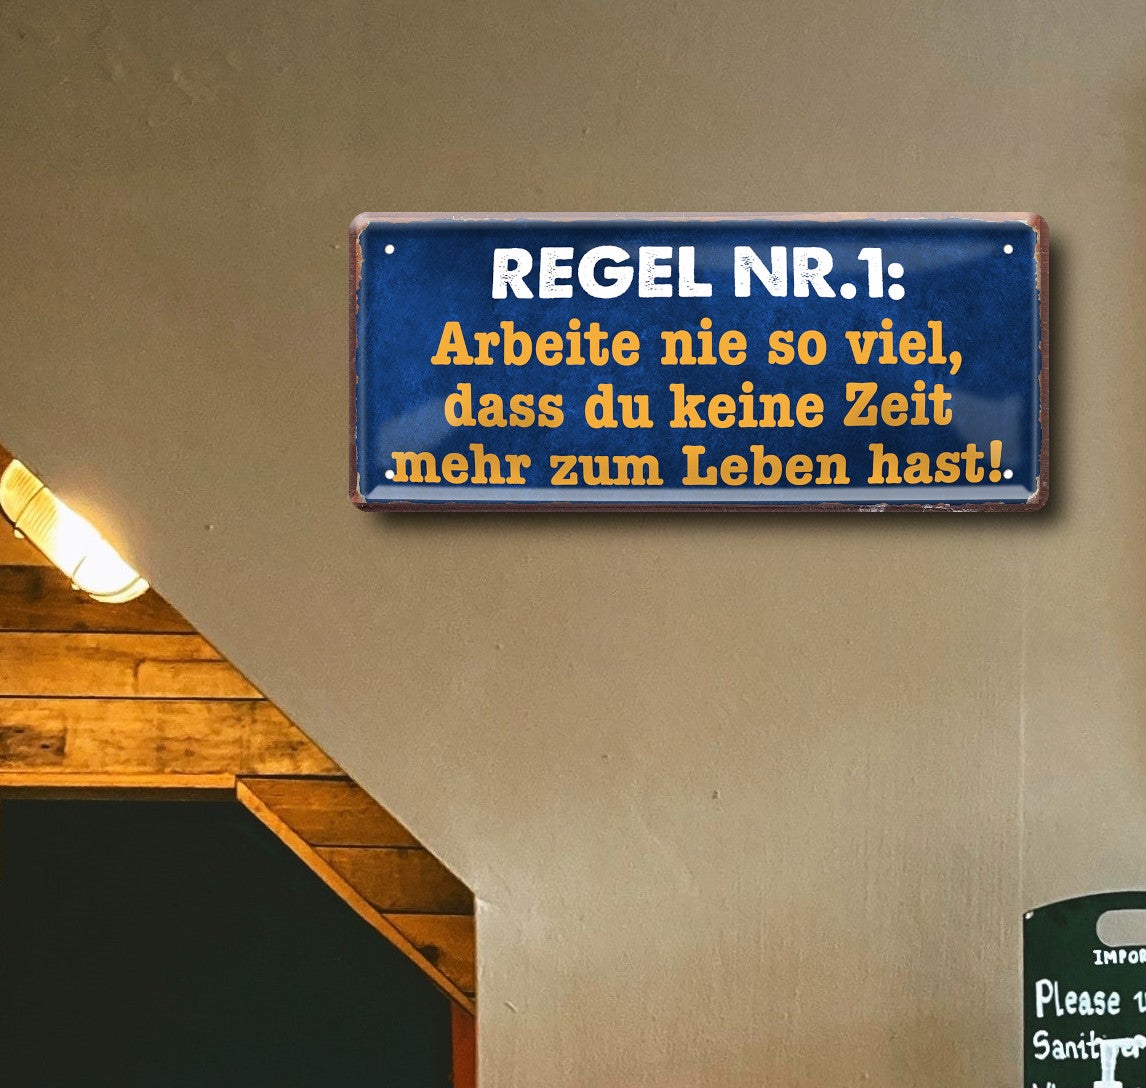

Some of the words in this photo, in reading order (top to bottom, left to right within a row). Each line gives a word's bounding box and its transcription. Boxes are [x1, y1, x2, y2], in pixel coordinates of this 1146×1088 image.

[491, 246, 713, 300] REGEL
[732, 245, 906, 301] NR.1:
[430, 319, 641, 366] Arbeite
[660, 318, 748, 366] nie
[768, 328, 828, 367] so
[845, 318, 963, 375] viel,
[443, 382, 564, 428] dass
[584, 382, 650, 429] du
[669, 382, 825, 429] keine
[843, 381, 953, 427] Zeit
[391, 446, 533, 485] mehr
[549, 450, 664, 486] zum
[682, 444, 851, 486] Leben
[867, 440, 1004, 484] hast!
[1035, 978, 1121, 1018] Please
